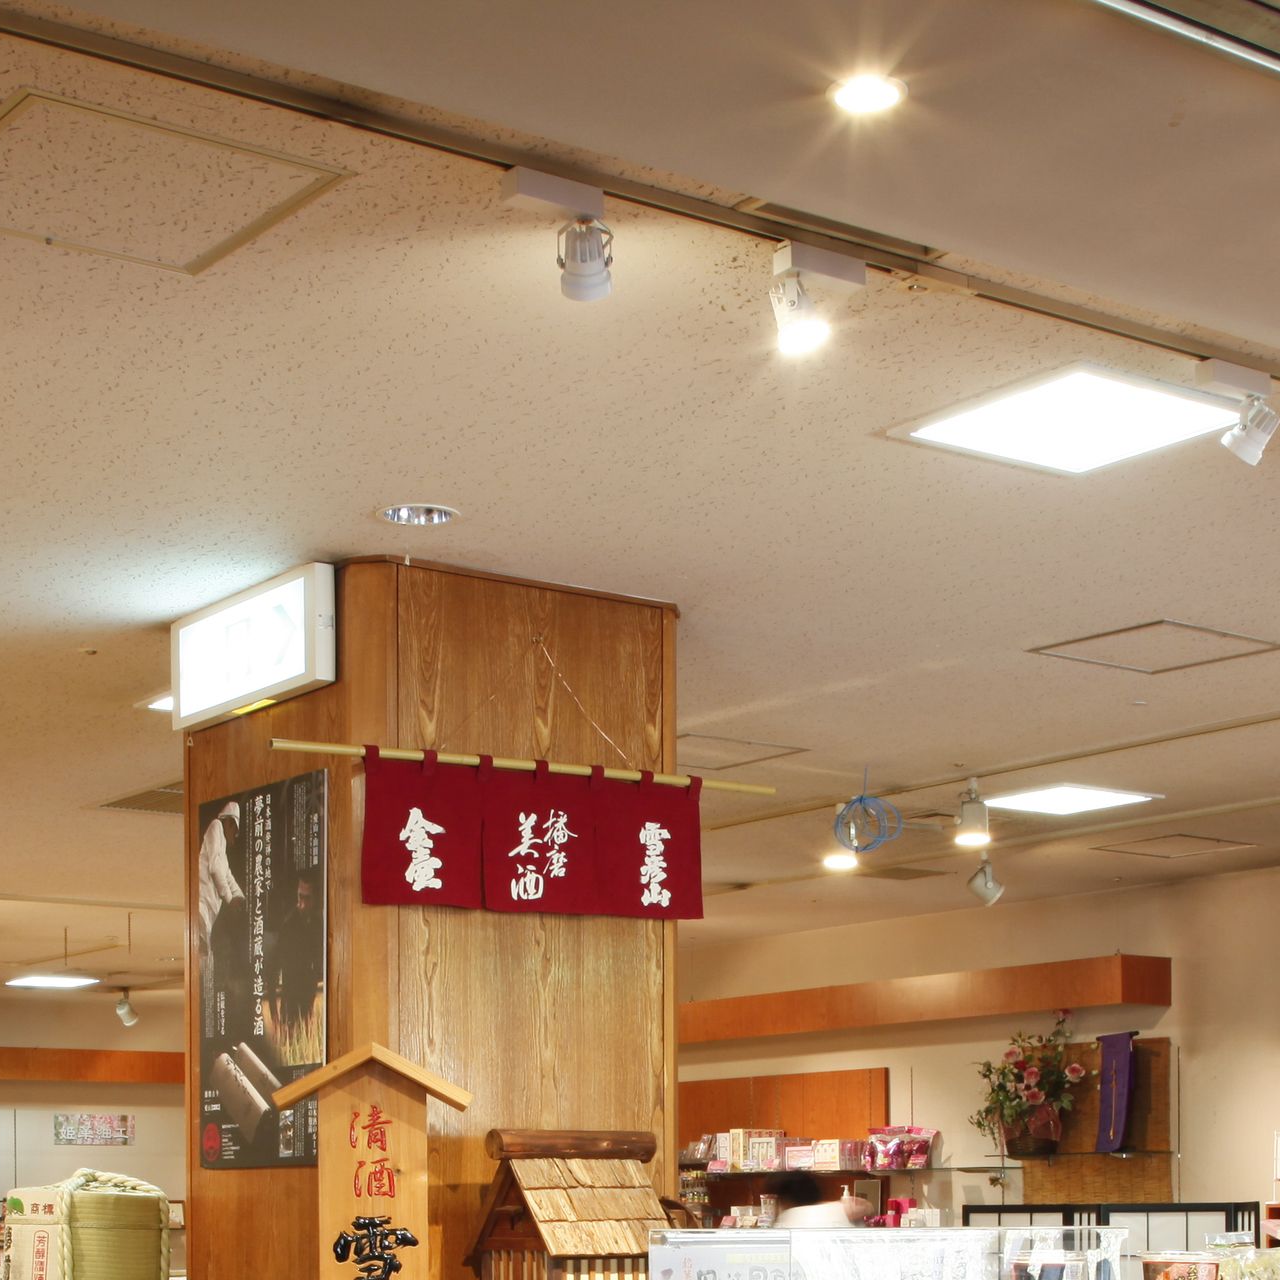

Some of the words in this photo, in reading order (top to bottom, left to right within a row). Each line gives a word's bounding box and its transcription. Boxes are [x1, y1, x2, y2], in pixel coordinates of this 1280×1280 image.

[507, 812, 545, 901] 美酒
[542, 809, 579, 879] 播磨
[253, 795, 264, 1036] 夢前の農家と酒蔵が造る酒
[348, 1103, 397, 1199] 清酒
[30, 1202, 55, 1216] 商標
